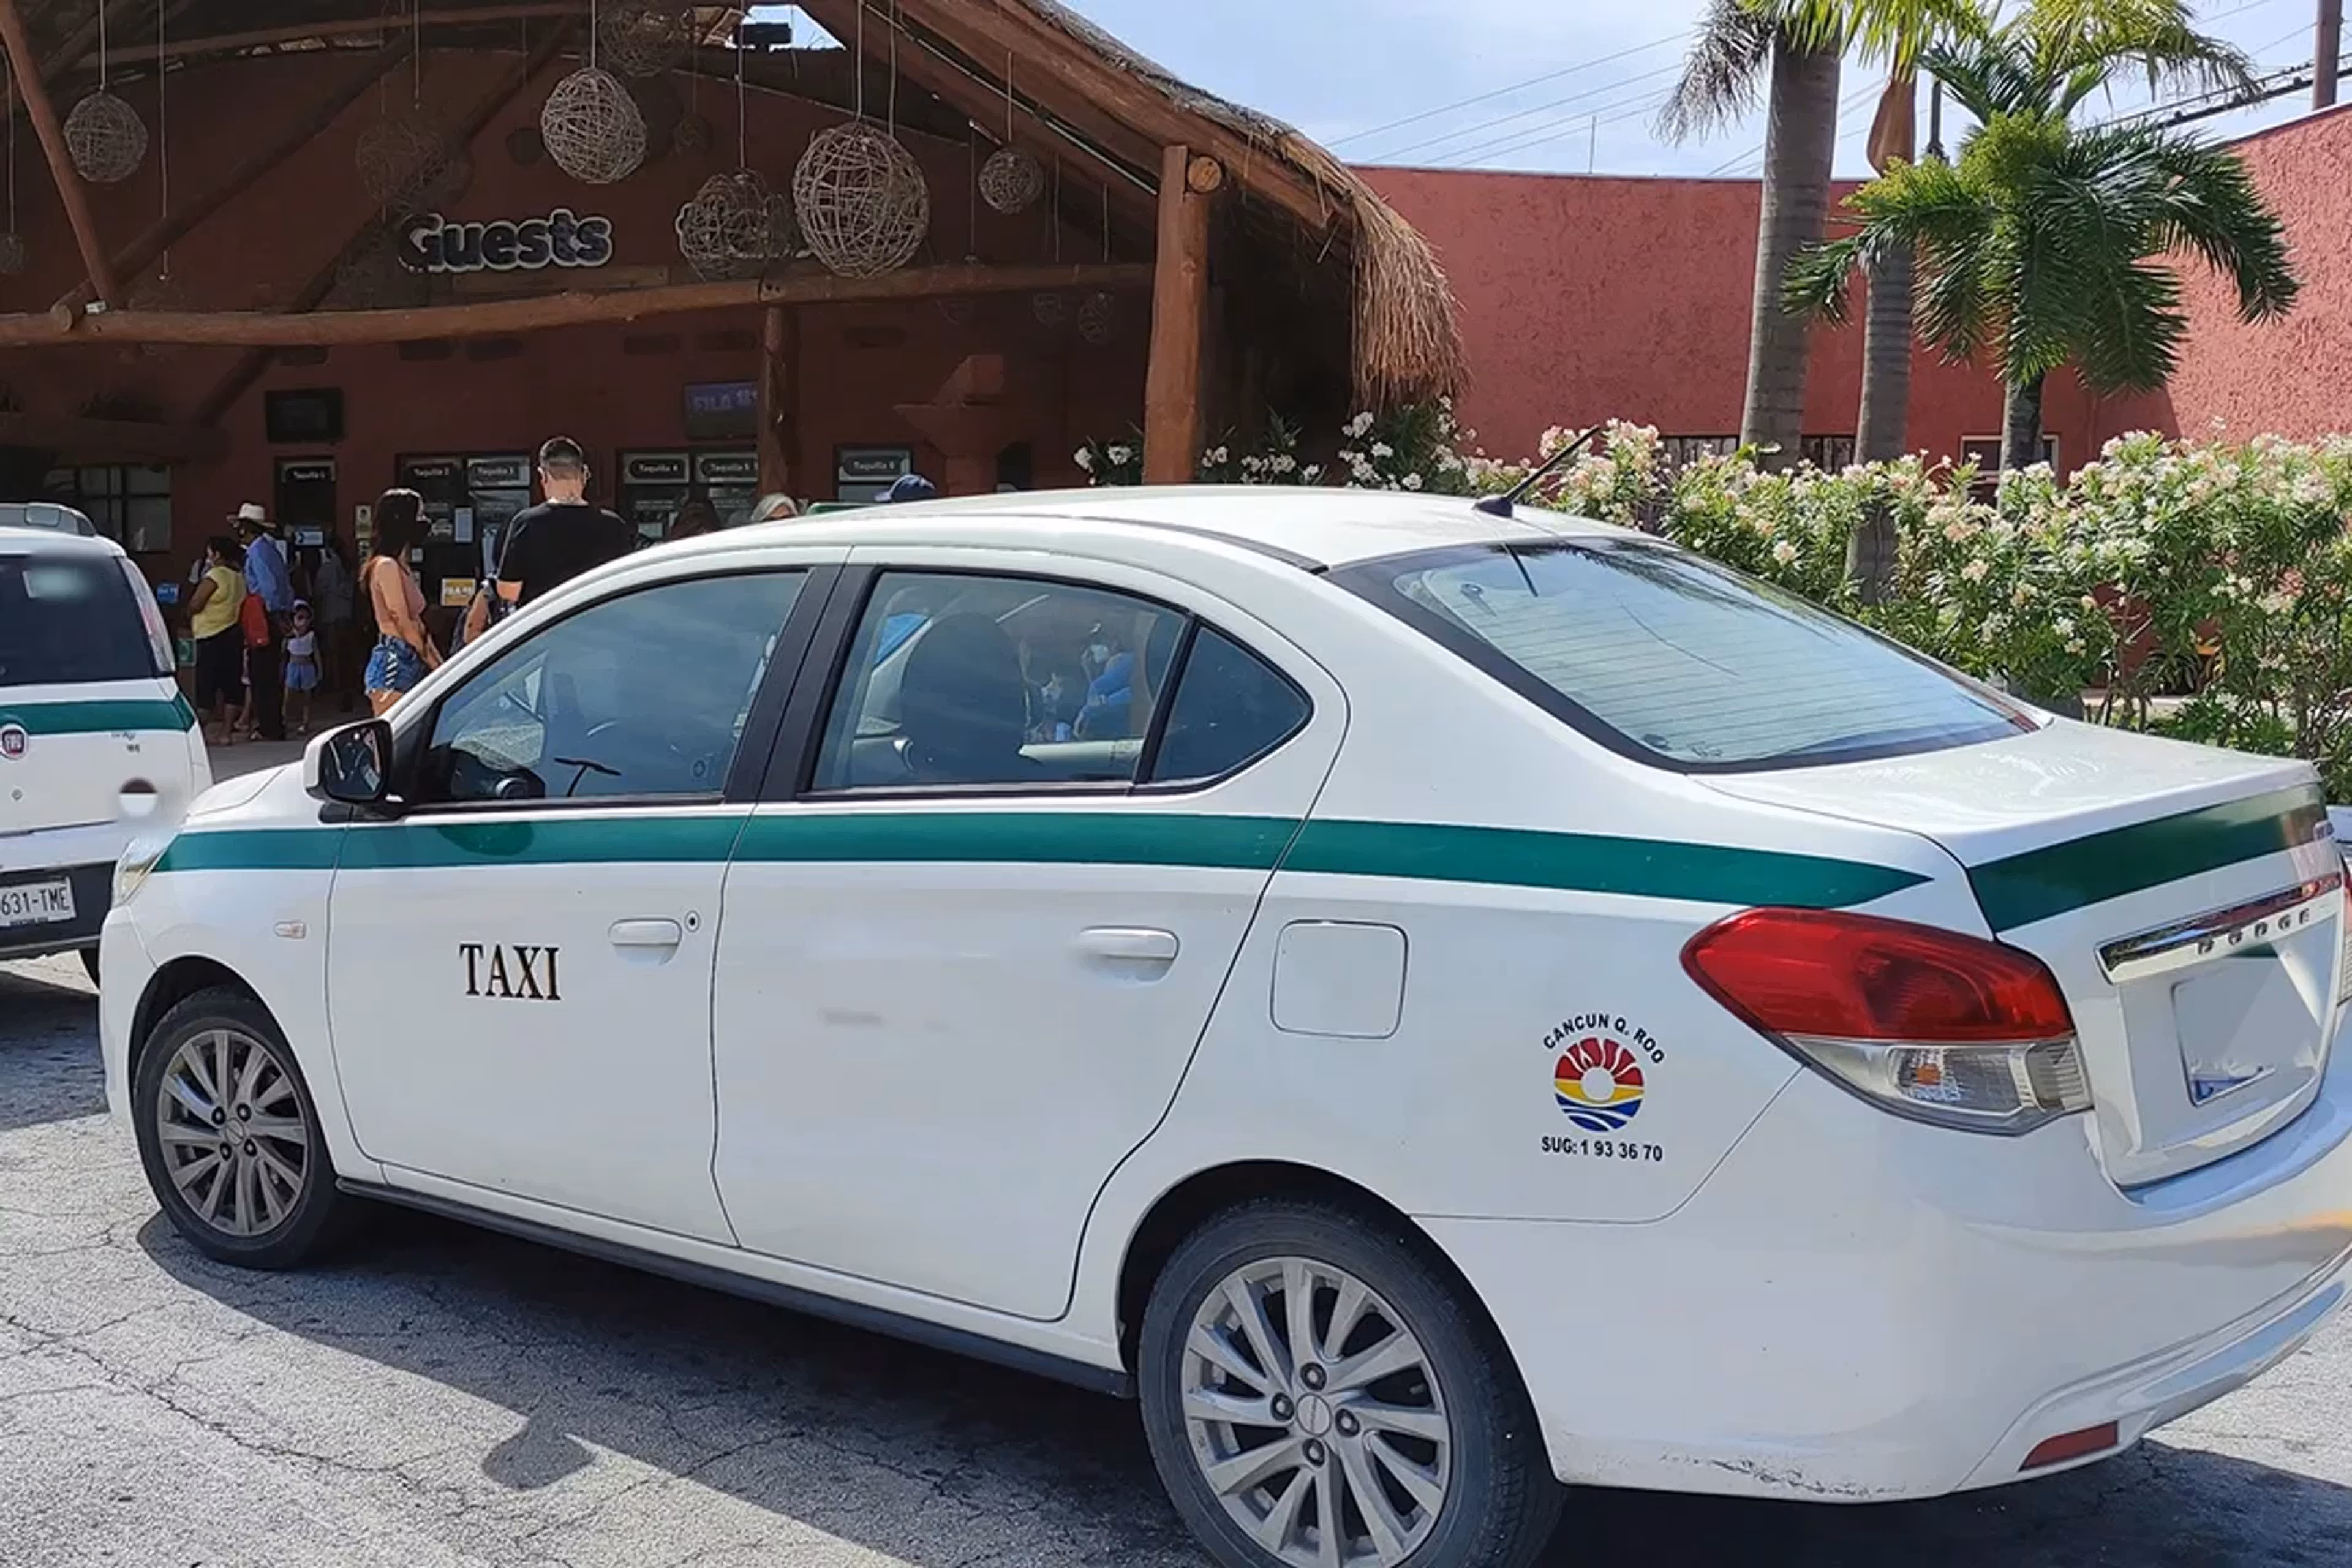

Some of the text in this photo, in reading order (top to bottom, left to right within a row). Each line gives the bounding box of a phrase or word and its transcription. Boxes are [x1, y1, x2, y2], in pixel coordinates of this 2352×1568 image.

[397, 208, 612, 273] Guests
[2195, 908, 2310, 956] DODGE
[459, 944, 561, 1001] TAXI
[1543, 1013, 1665, 1064] CANCUN Q. ROO
[1594, 1140, 1614, 1158] 93
[1618, 1142, 1638, 1159] 36
[1643, 1145, 1664, 1162] 70
